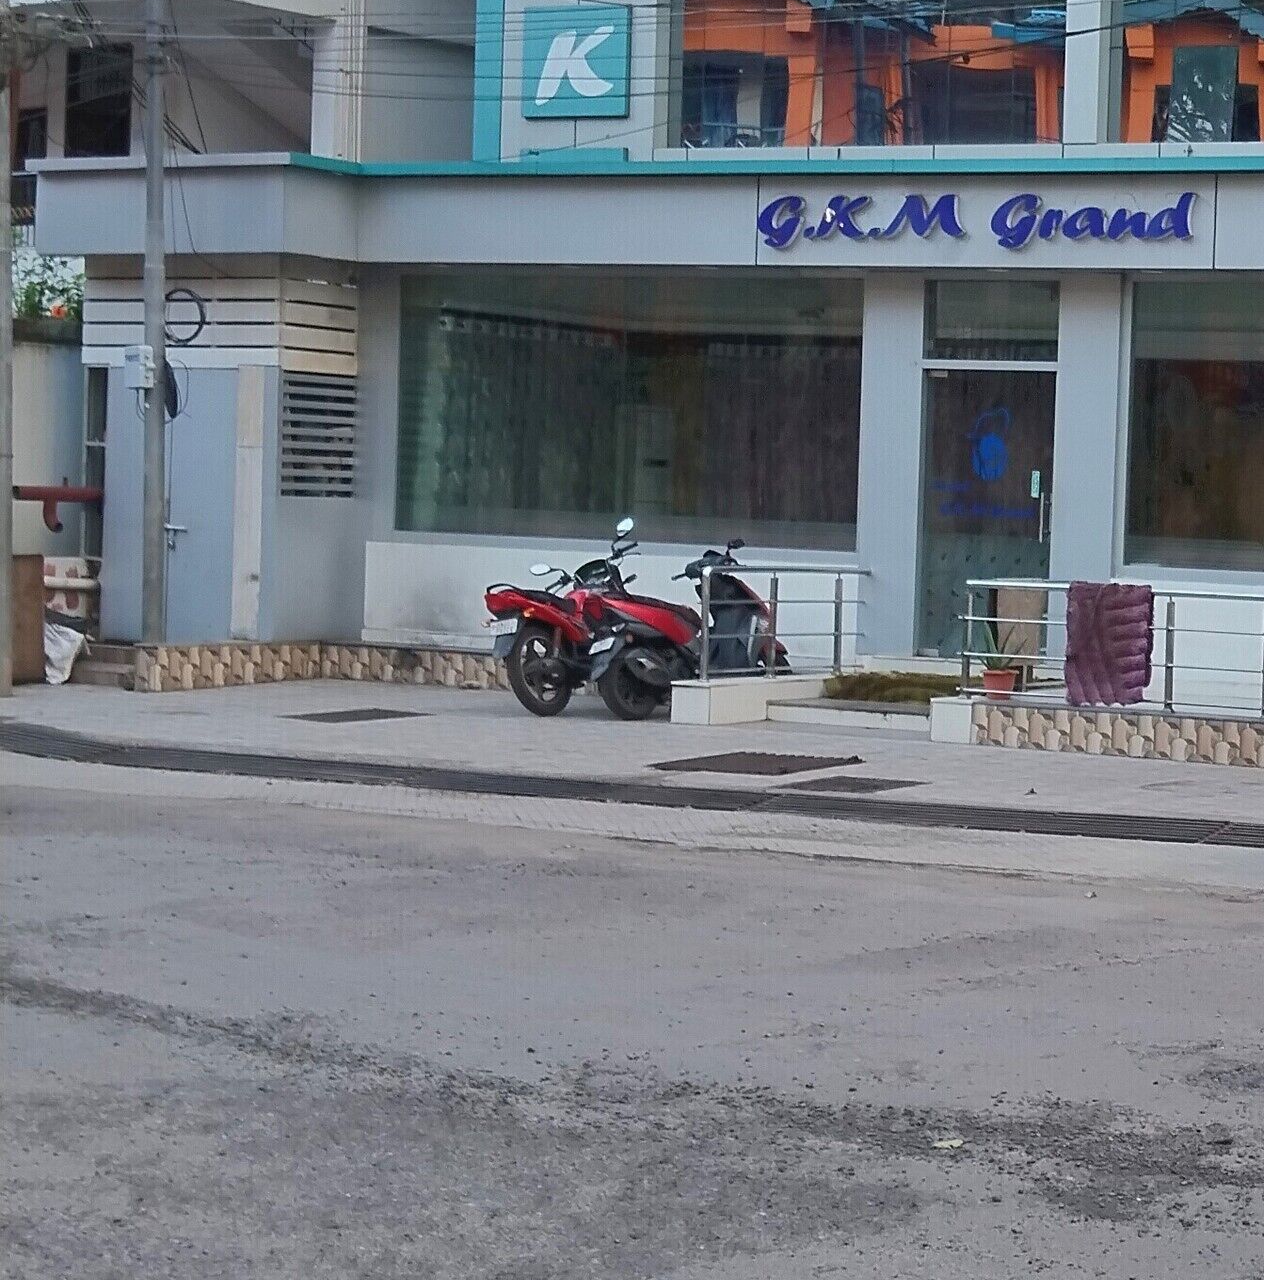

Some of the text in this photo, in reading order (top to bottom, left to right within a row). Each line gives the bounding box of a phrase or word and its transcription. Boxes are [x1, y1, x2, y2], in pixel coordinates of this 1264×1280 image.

[535, 25, 614, 106] K
[757, 192, 1199, 251] G.K.M Grand
